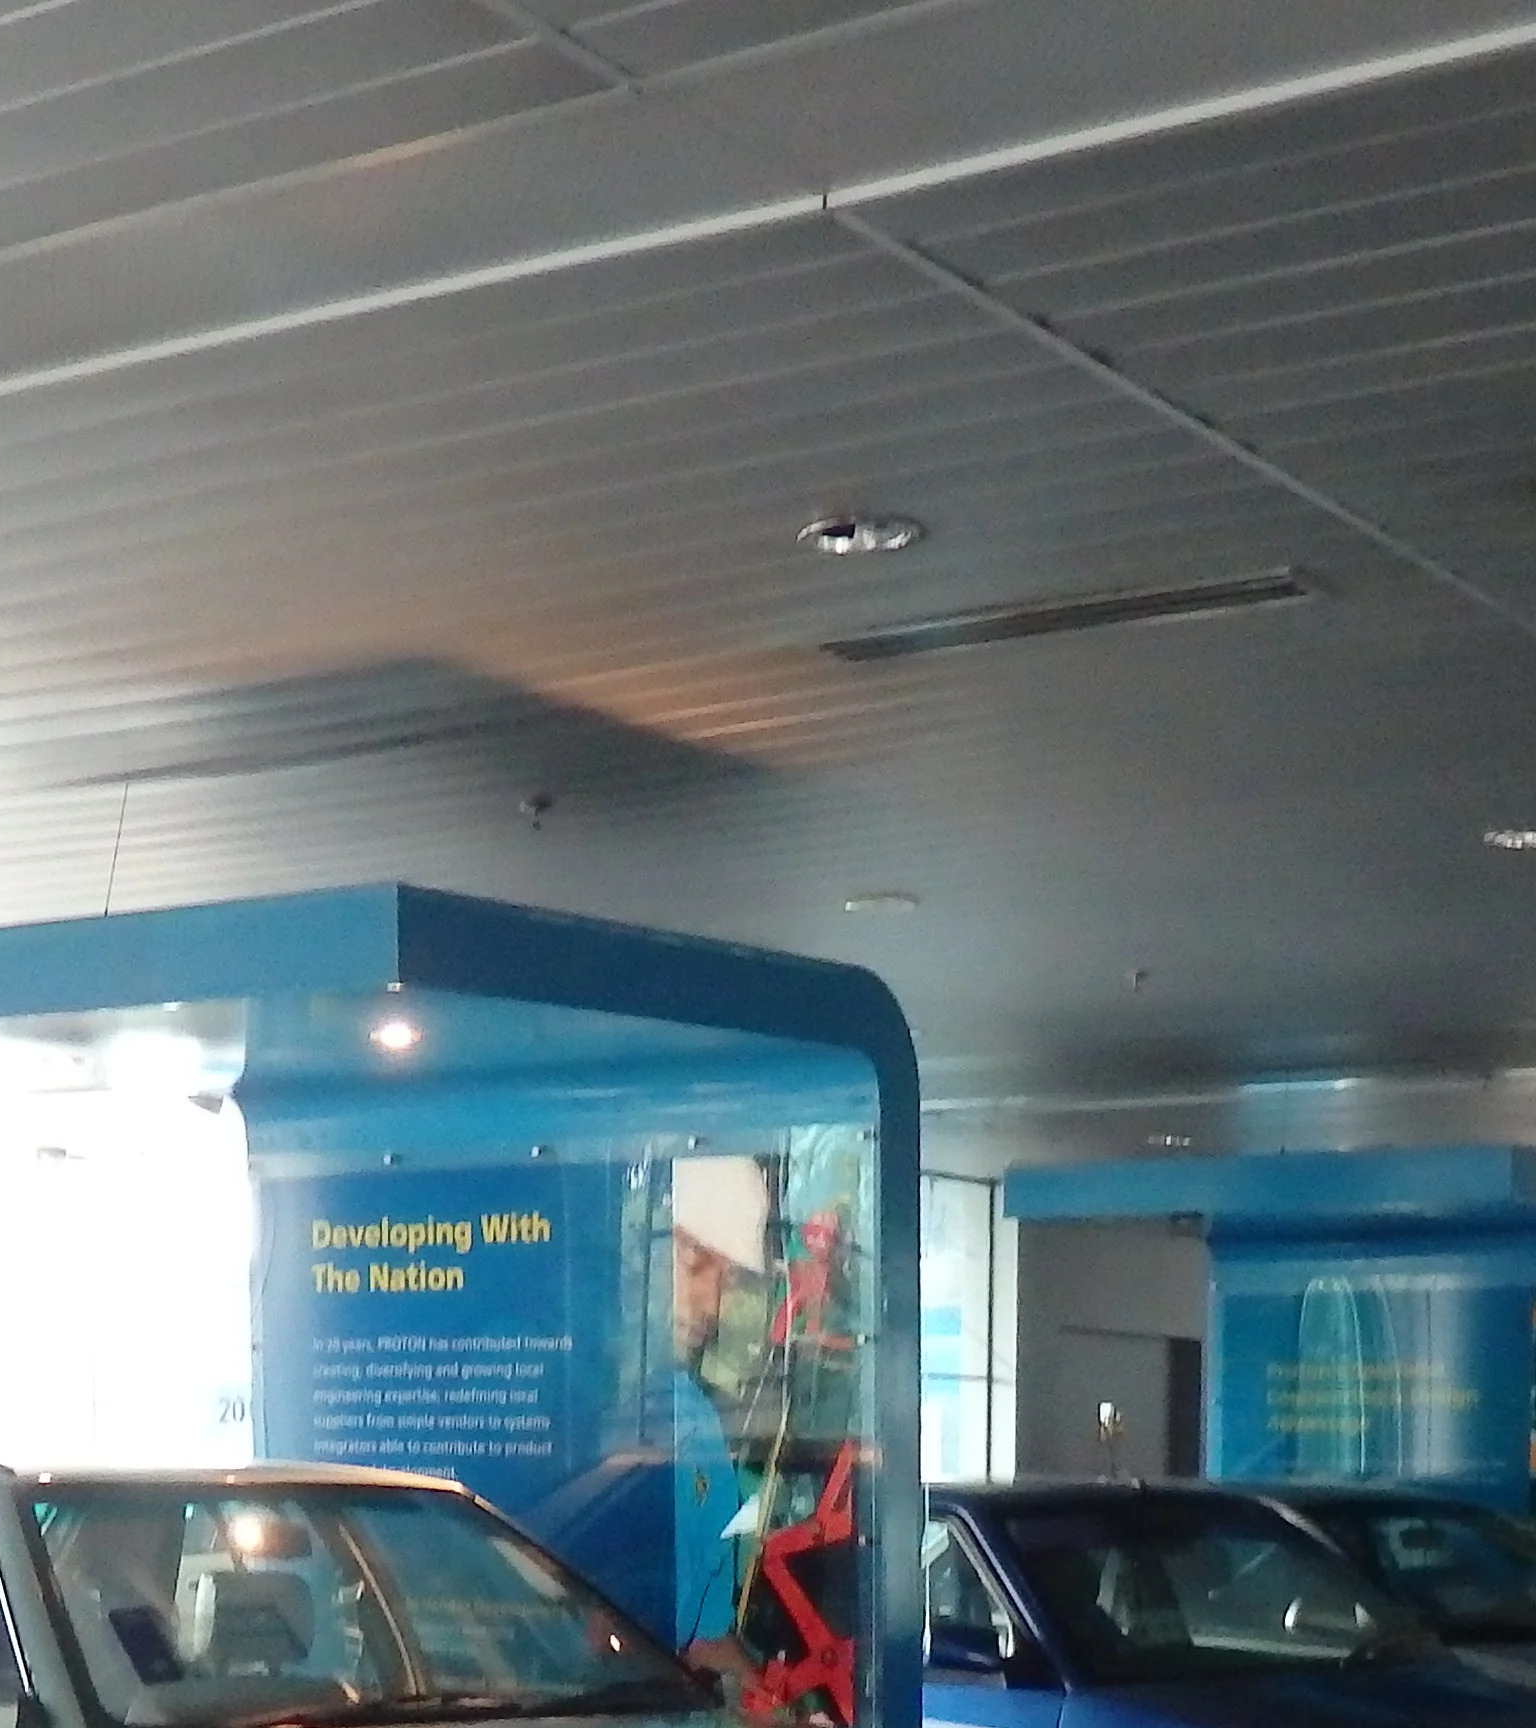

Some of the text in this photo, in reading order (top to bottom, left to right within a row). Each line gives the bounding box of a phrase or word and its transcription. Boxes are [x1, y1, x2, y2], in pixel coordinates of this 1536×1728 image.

[312, 1210, 551, 1254] Developing With
[312, 1259, 464, 1294] The Nation
[378, 1335, 426, 1352] PROTON
